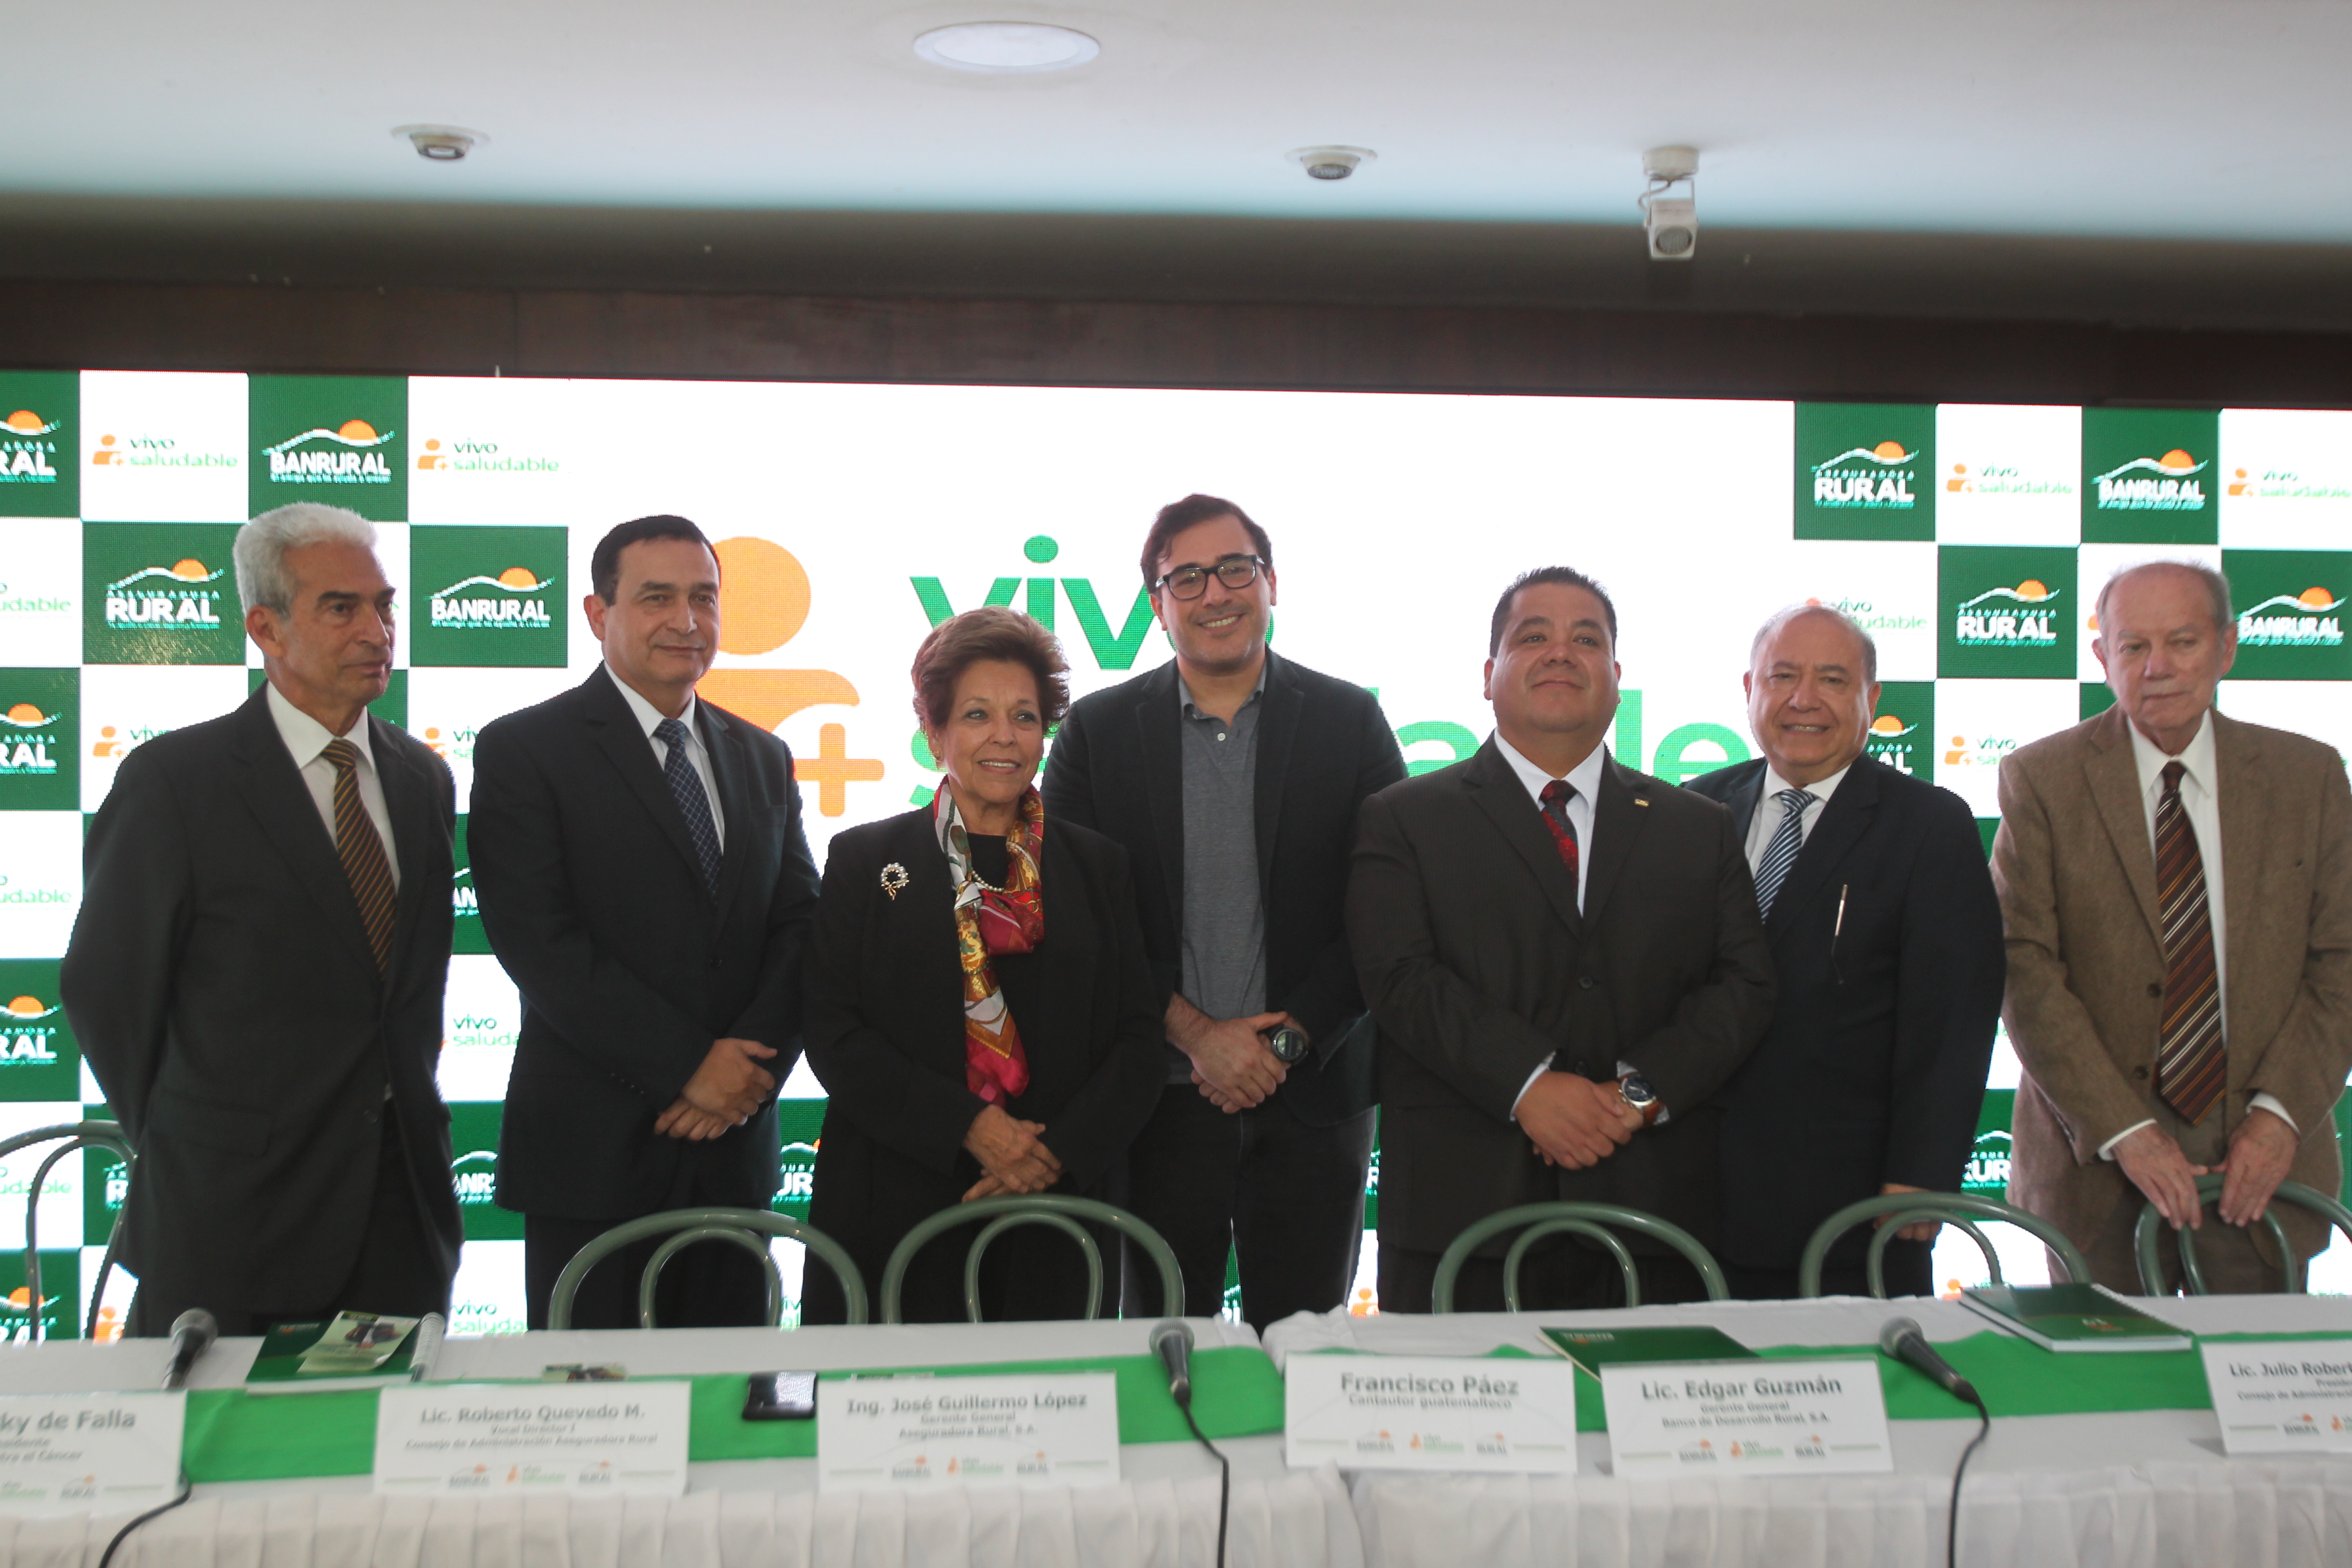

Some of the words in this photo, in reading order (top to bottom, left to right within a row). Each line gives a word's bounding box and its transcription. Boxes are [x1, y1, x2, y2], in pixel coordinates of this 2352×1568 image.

[130, 433, 174, 450] vivo
[454, 438, 498, 454] vivo
[130, 453, 238, 466] saludable
[270, 451, 392, 476] BANRURAL
[454, 457, 559, 471] saludable
[1980, 462, 2018, 477] vivo
[1814, 477, 1915, 502] RURAL
[1979, 480, 2073, 494] saludable
[2098, 478, 2206, 502] BANRURAL
[105, 597, 221, 624] RURAL
[431, 598, 551, 621] BANRURAL
[1957, 615, 2058, 640] RURAL
[2237, 615, 2345, 639] BANRURAL
[1977, 735, 2017, 750] vivo
[453, 1014, 498, 1030] vivo
[453, 1299, 497, 1315] vivo
[2229, 1362, 2257, 1377] Lic.
[2260, 1361, 2299, 1376] Julio
[1341, 1372, 1455, 1393] Francisco
[1463, 1373, 1519, 1395] Páez
[1642, 1382, 1678, 1400] Lic.
[1685, 1378, 1747, 1401] Edgar
[1754, 1374, 1842, 1395] Guzmán
[420, 1408, 452, 1424] Lic.
[458, 1406, 533, 1424] Roberto
[537, 1404, 619, 1423] Quevedo
[625, 1403, 646, 1419] M.
[847, 1397, 885, 1416] Ing.
[891, 1394, 933, 1413] José
[938, 1393, 1028, 1411] Guillermo
[1034, 1390, 1089, 1410] López
[37, 1410, 70, 1431] de
[76, 1408, 137, 1431] Falla
